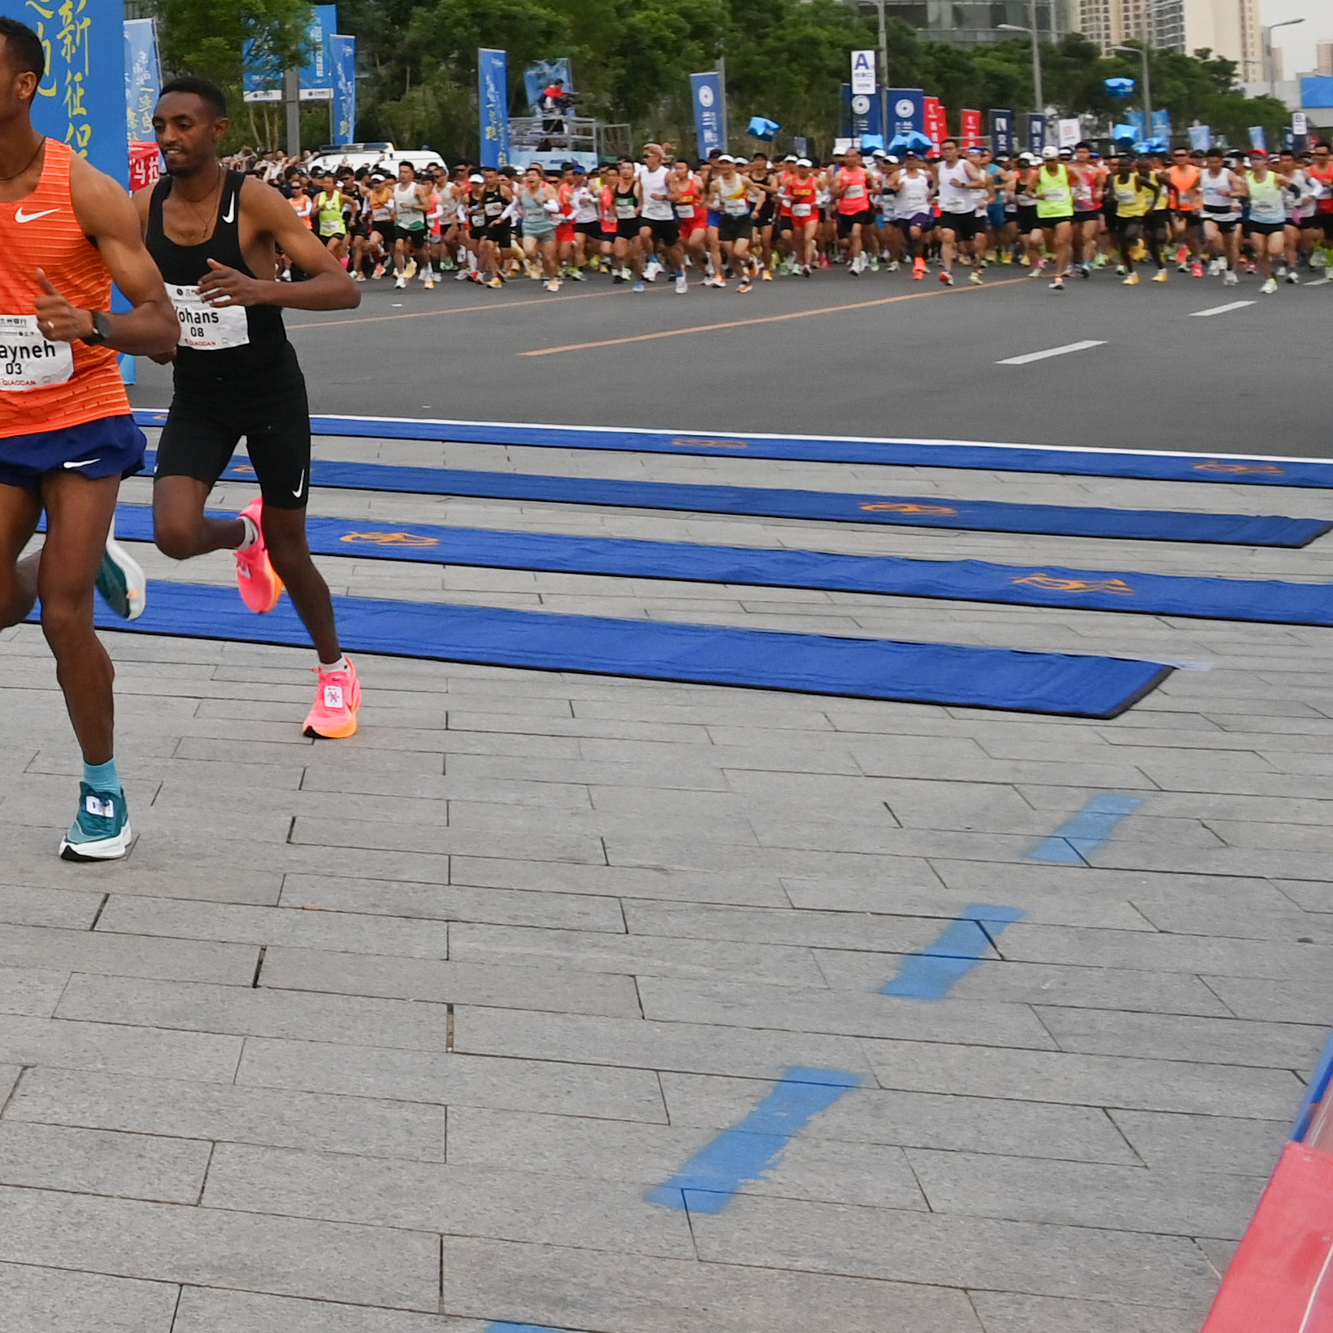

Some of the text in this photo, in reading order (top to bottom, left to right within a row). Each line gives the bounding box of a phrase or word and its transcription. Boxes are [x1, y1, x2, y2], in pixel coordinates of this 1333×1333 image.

[854, 53, 870, 70] A
[190, 327, 205, 337] 08
[5, 363, 22, 375] 03
